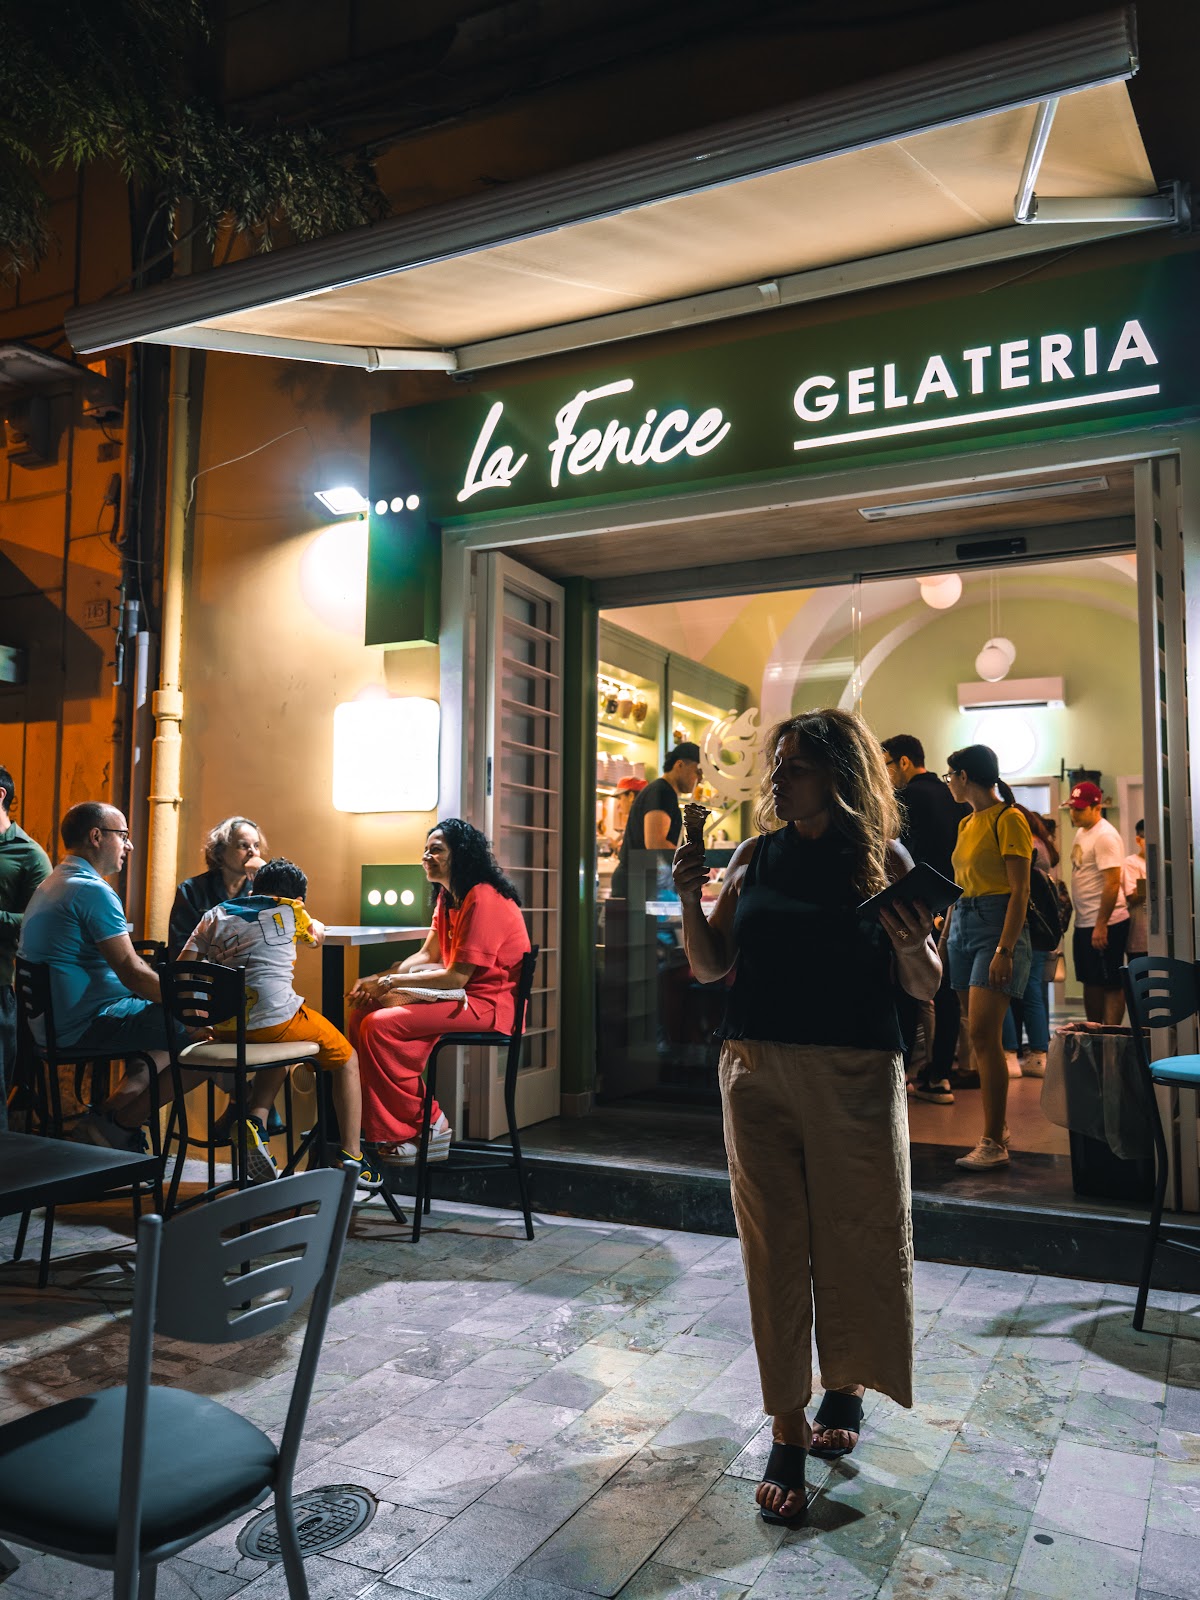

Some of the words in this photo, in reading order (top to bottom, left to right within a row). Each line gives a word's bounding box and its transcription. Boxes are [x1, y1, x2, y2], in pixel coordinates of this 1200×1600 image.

[793, 319, 1159, 422] GELATERIA
[456, 401, 529, 503] La
[547, 378, 732, 488] Fenice
